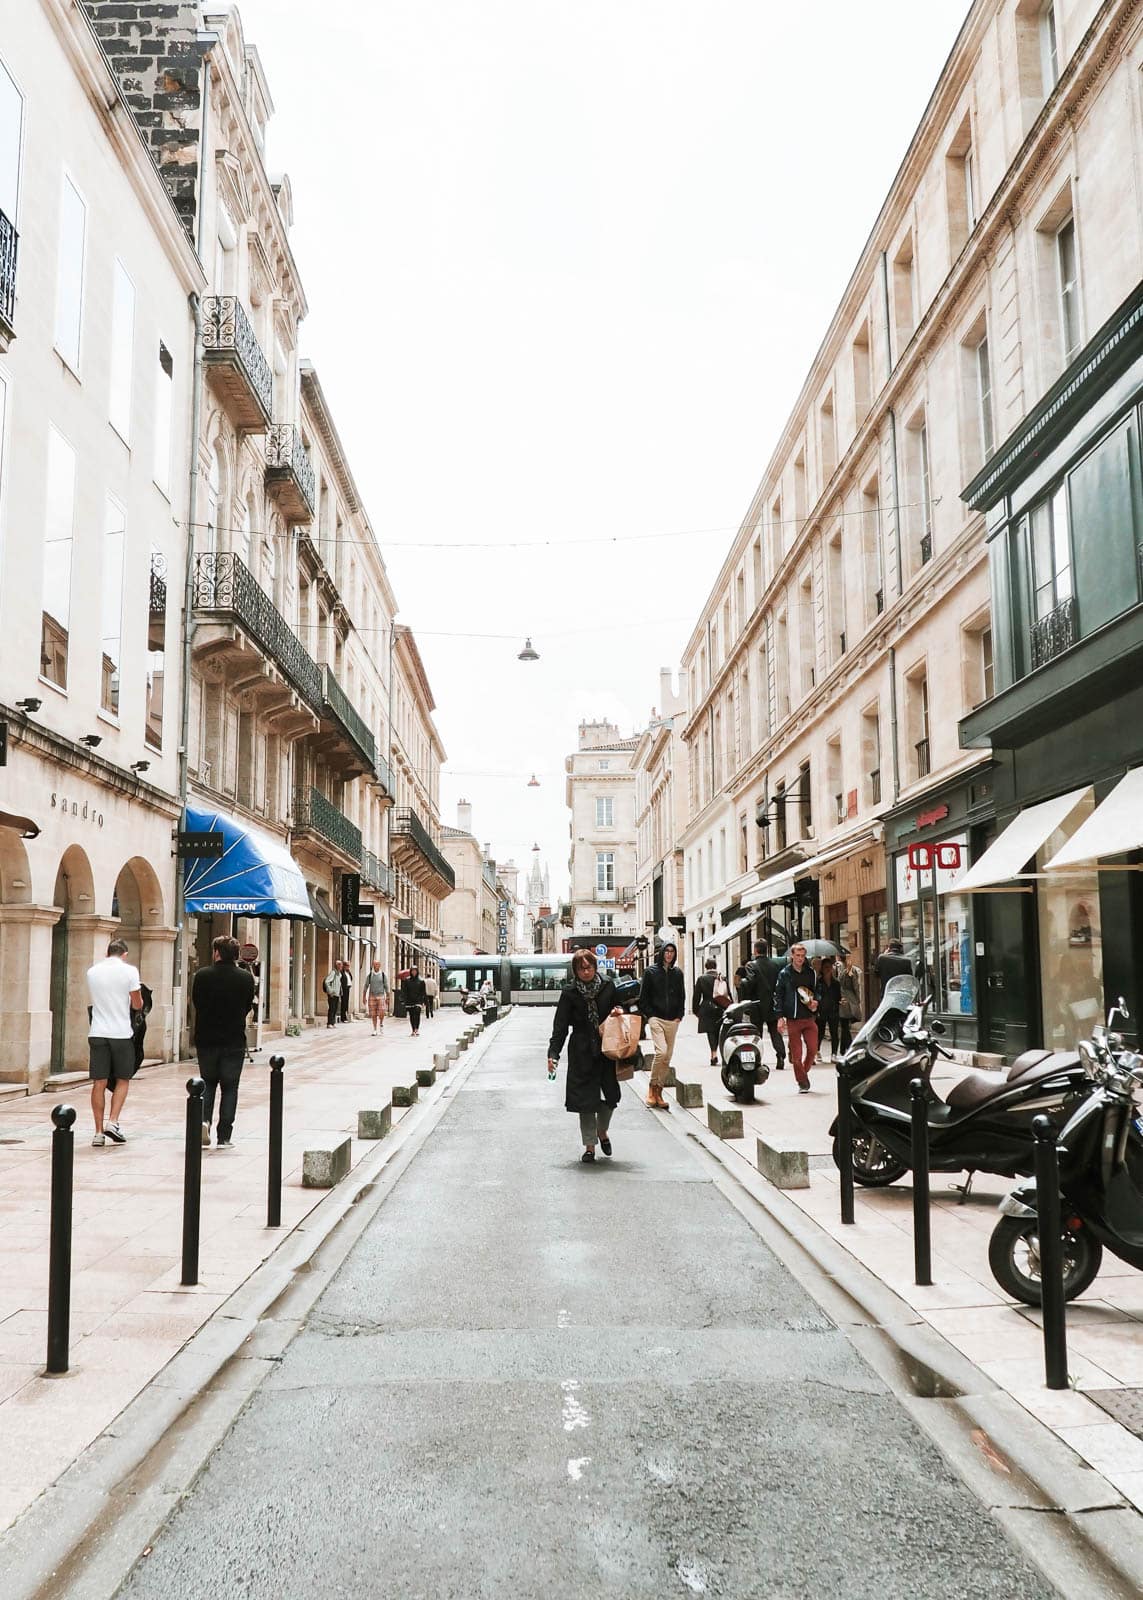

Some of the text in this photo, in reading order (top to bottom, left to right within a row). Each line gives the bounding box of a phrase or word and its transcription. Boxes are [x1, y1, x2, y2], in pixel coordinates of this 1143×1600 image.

[51, 793, 104, 828] sandro
[178, 840, 222, 848] sandro
[203, 903, 256, 911] CENDRILLON
[499, 901, 507, 952] FEMINA
